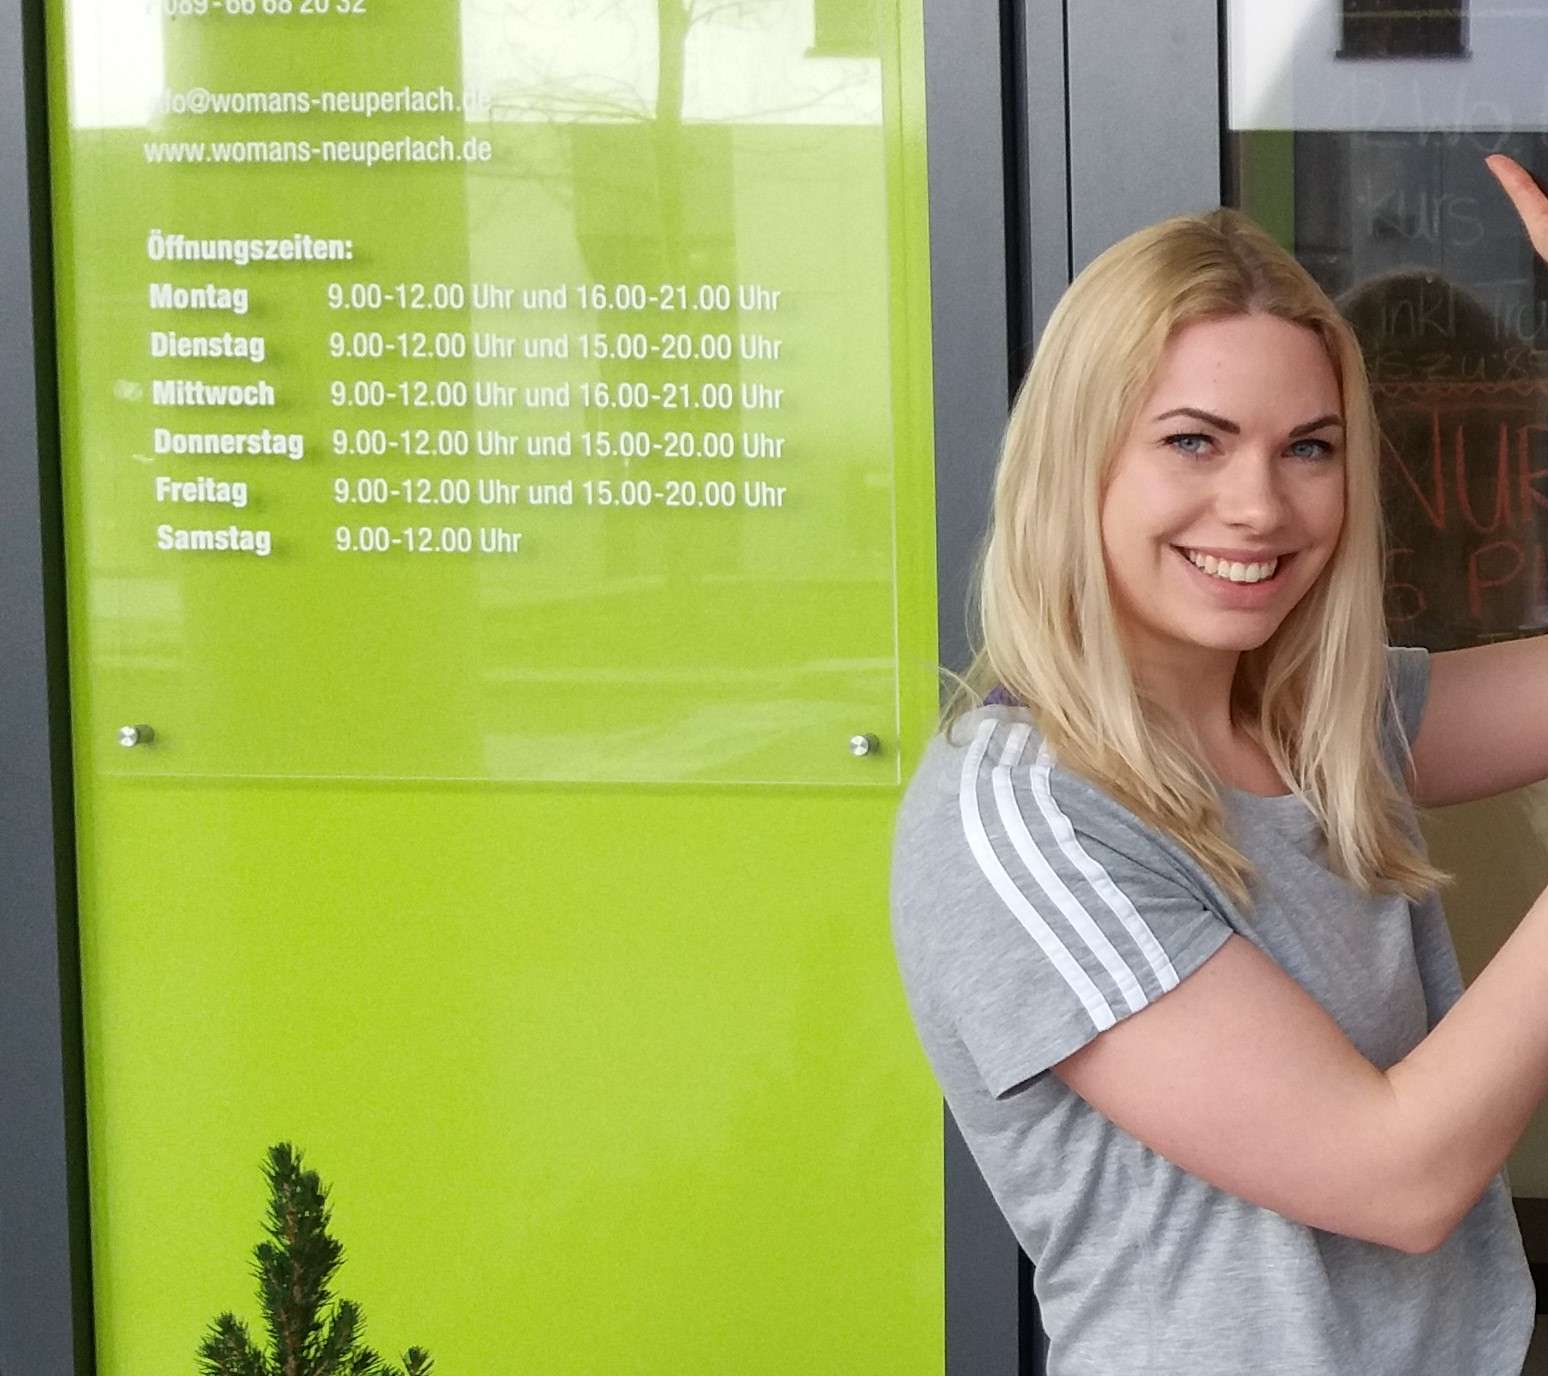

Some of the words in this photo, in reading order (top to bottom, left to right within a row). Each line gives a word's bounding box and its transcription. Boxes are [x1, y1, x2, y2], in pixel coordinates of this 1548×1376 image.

[143, 135, 492, 167] www.womans-neuperlach.de
[147, 229, 354, 265] Öffnungszeiten:
[149, 283, 249, 315] Montag
[327, 283, 466, 309] 9.00-12.00
[472, 284, 514, 310] Uhr
[523, 284, 567, 310] und
[576, 284, 731, 310] 16.00-21.00
[739, 285, 781, 311] Uhr
[150, 331, 265, 362] Dienstag
[329, 332, 467, 358] 9.00-12.00
[473, 333, 516, 359] Uhr
[524, 333, 568, 359] und
[578, 334, 732, 360] 15.00-20.00
[740, 334, 783, 360] Uhr
[152, 380, 275, 407] Mittwoch
[331, 381, 468, 407] 9.00-12.00
[475, 382, 517, 408] Uhr
[526, 382, 569, 408] und
[580, 382, 733, 409] 16.00-21.00
[741, 383, 784, 409] Uhr
[154, 428, 304, 460] Donnerstag
[332, 430, 469, 456] 9.00-12.00
[477, 431, 519, 457] Uhr
[528, 431, 571, 457] und
[581, 432, 735, 458] 15.00-20.00
[743, 432, 785, 459] Uhr
[156, 477, 248, 508] Freitag
[334, 478, 470, 504] 9.00-12.00
[478, 479, 520, 505] Uhr
[529, 480, 573, 506] und
[583, 480, 736, 507] 15.00-20.00
[745, 481, 787, 507] Uhr
[157, 525, 272, 557] Samstag
[336, 527, 472, 553] 9.00-12.00
[480, 527, 522, 553] Uhr
